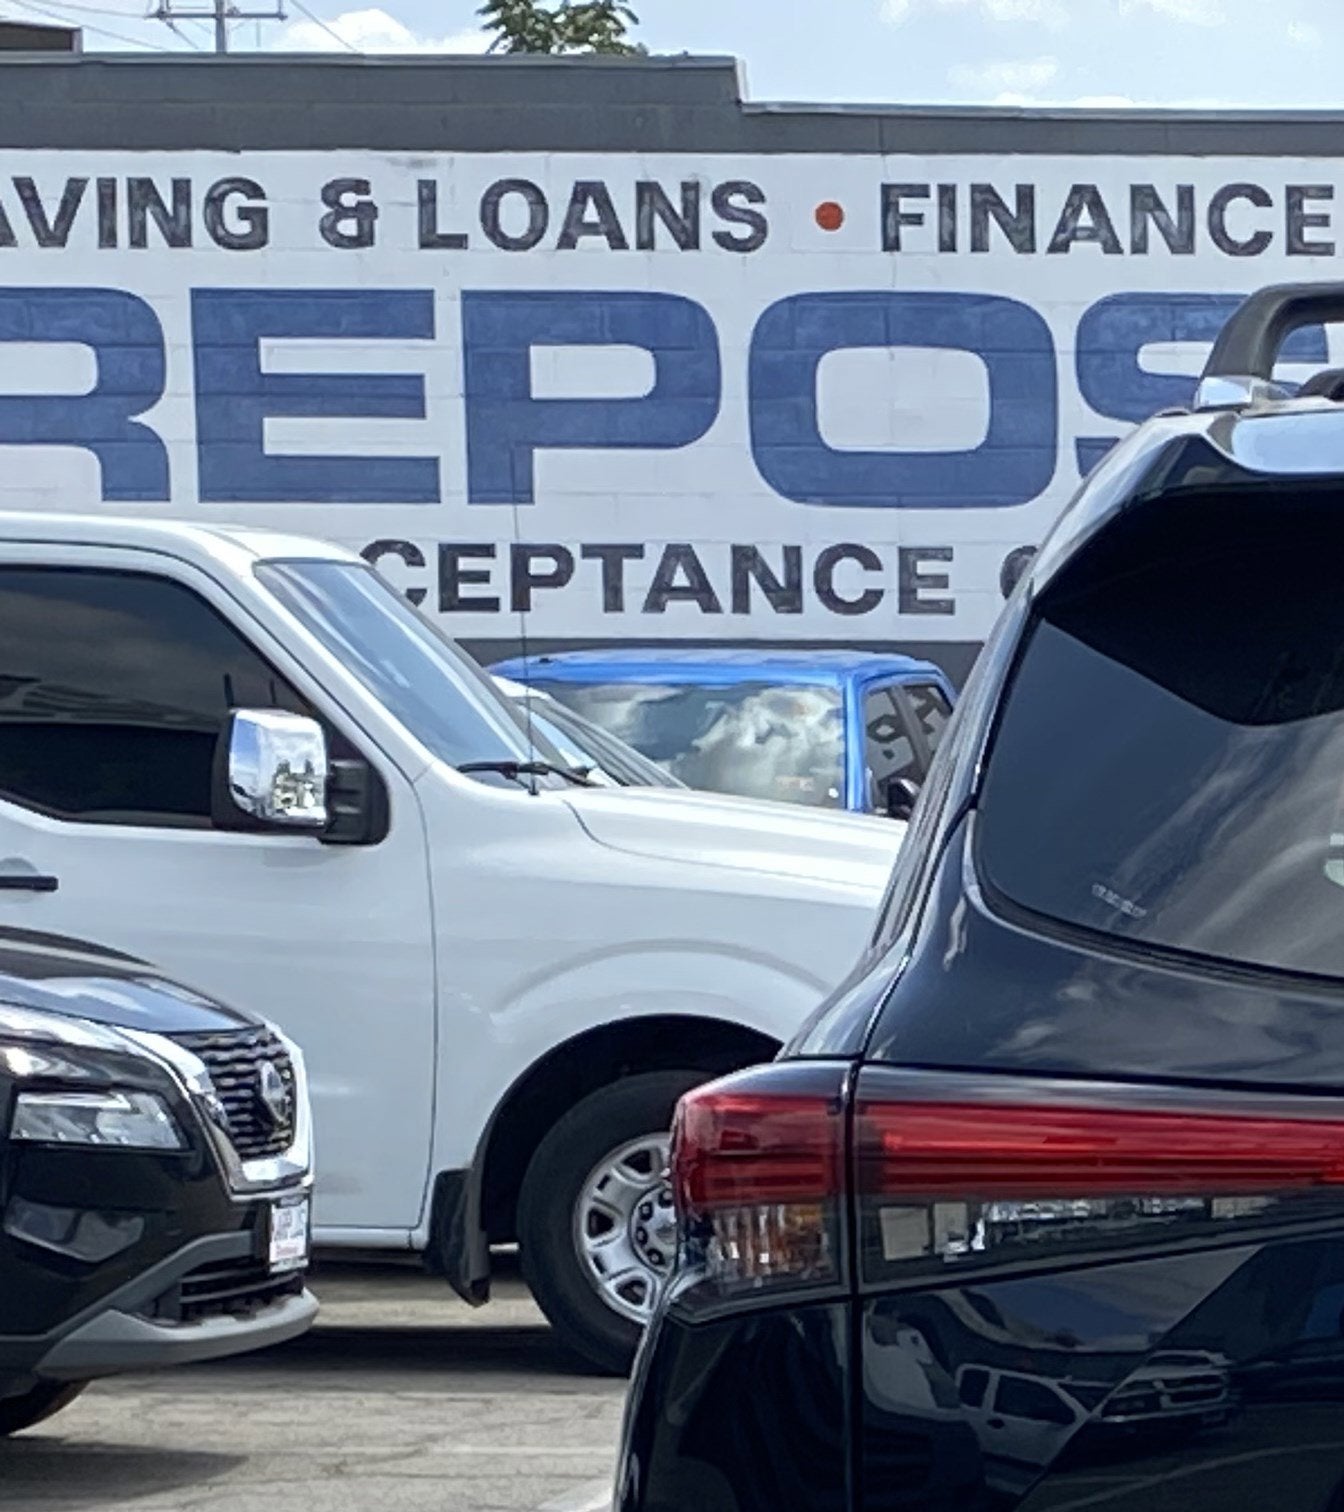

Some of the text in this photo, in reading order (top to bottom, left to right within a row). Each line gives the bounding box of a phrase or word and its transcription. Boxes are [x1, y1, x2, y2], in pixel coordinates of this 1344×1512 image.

[319, 178, 379, 250] &
[418, 179, 768, 253] LOANS
[881, 183, 1336, 257] FINANCE
